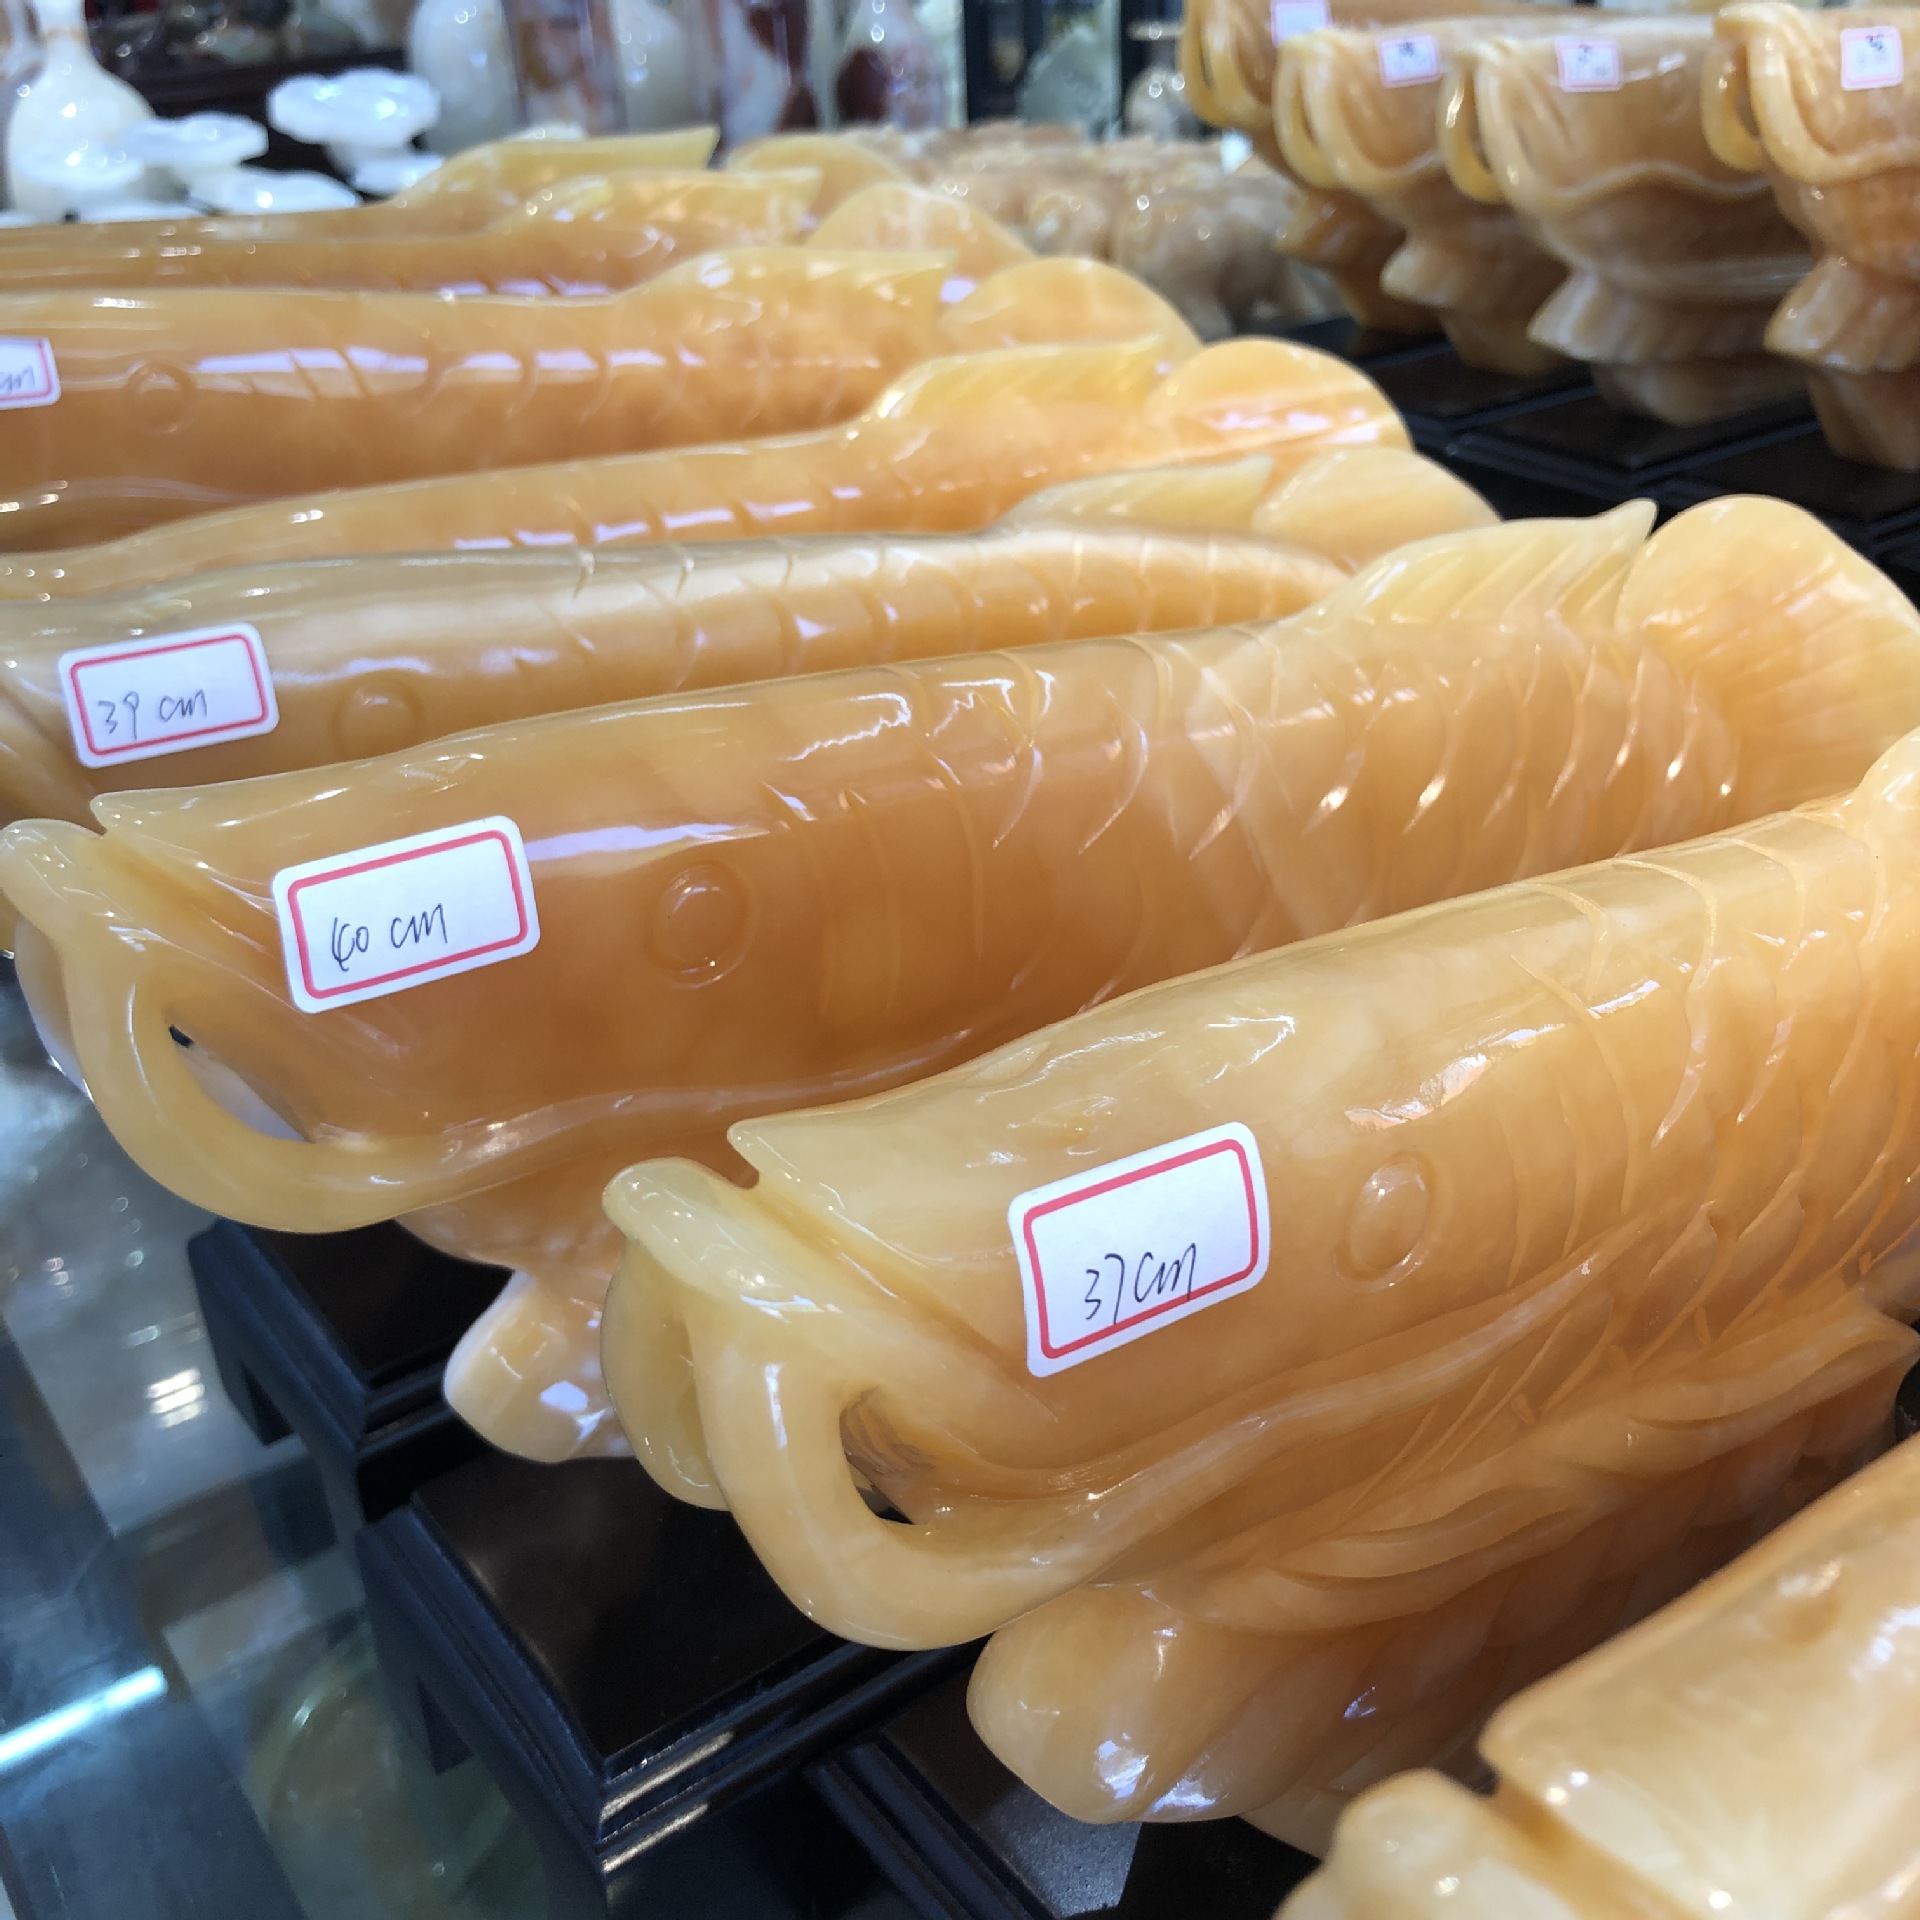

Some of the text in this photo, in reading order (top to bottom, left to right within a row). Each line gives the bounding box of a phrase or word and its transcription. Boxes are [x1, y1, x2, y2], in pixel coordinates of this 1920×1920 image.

[97, 688, 208, 740] 39 cm
[390, 902, 448, 949] cm
